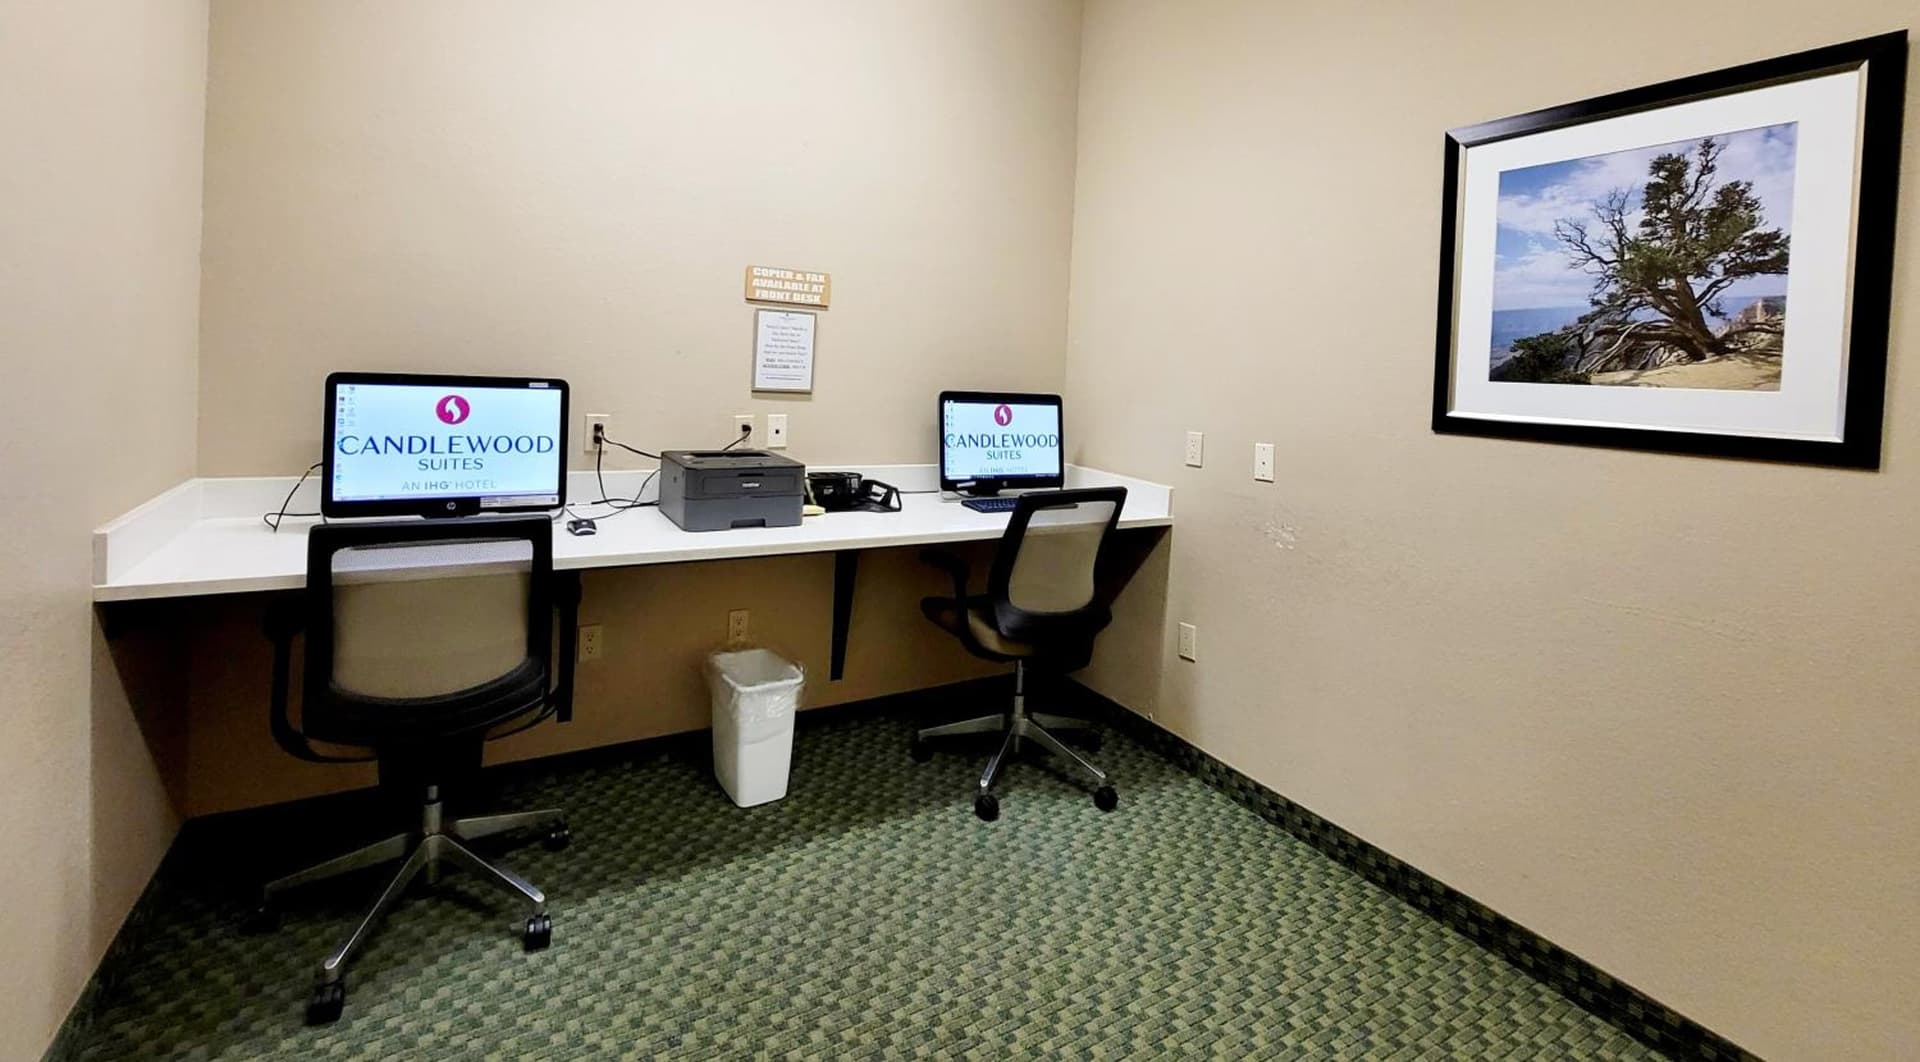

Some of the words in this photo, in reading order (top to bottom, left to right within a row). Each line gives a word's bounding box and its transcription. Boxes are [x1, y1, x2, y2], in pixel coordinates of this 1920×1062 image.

[753, 267, 793, 279] COPIER
[806, 273, 825, 283] FAX
[752, 278, 810, 291] AVAILABLE
[812, 284, 824, 294] AT
[755, 289, 791, 300] FRONT
[792, 292, 822, 303] DESK
[339, 435, 553, 456] CANDLEWOOD
[945, 433, 1058, 449] CANDLEWOOD
[986, 450, 1022, 460] SUITES
[418, 457, 483, 471] SUITES
[401, 481, 419, 491] AN
[456, 480, 497, 490] HOTEL
